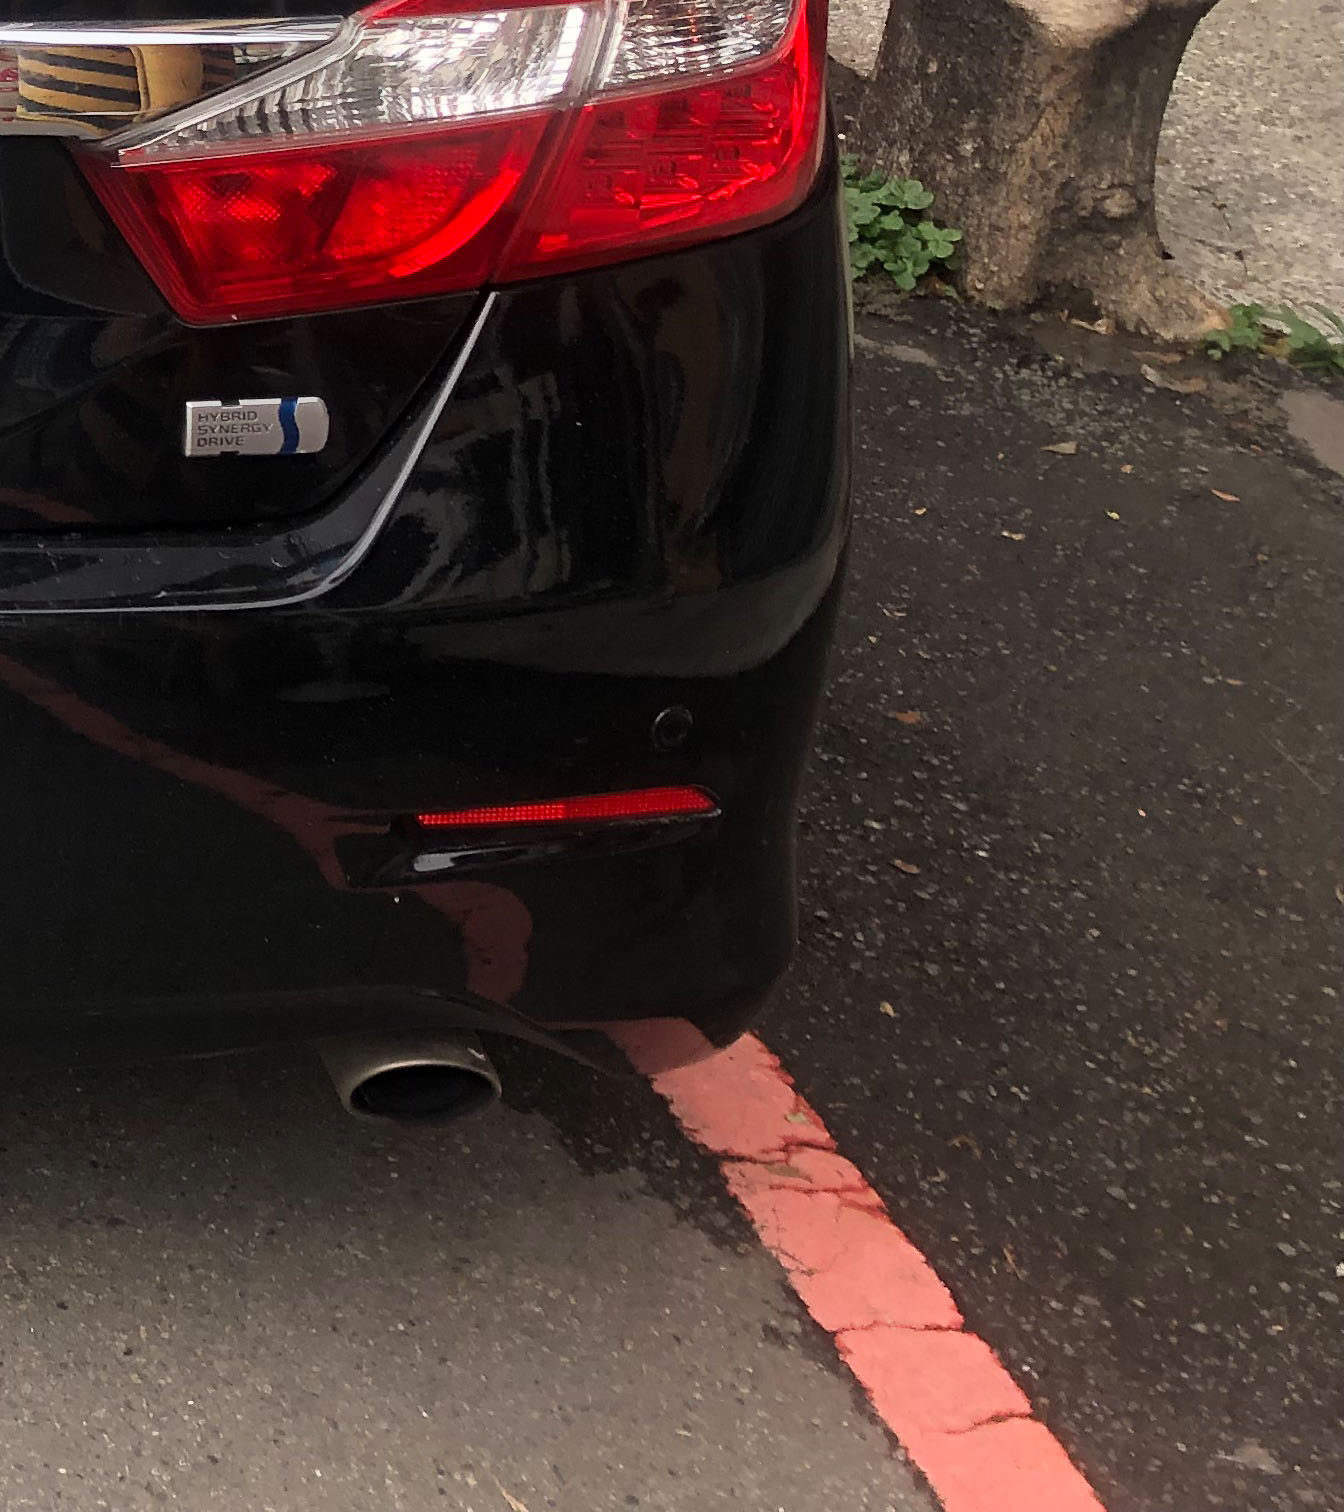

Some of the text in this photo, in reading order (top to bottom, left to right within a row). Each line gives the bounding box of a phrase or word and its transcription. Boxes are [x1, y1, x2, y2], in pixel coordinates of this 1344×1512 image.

[198, 411, 258, 423] HYBRID
[197, 423, 274, 436] SYNERGY
[196, 437, 245, 448] DRIVE
